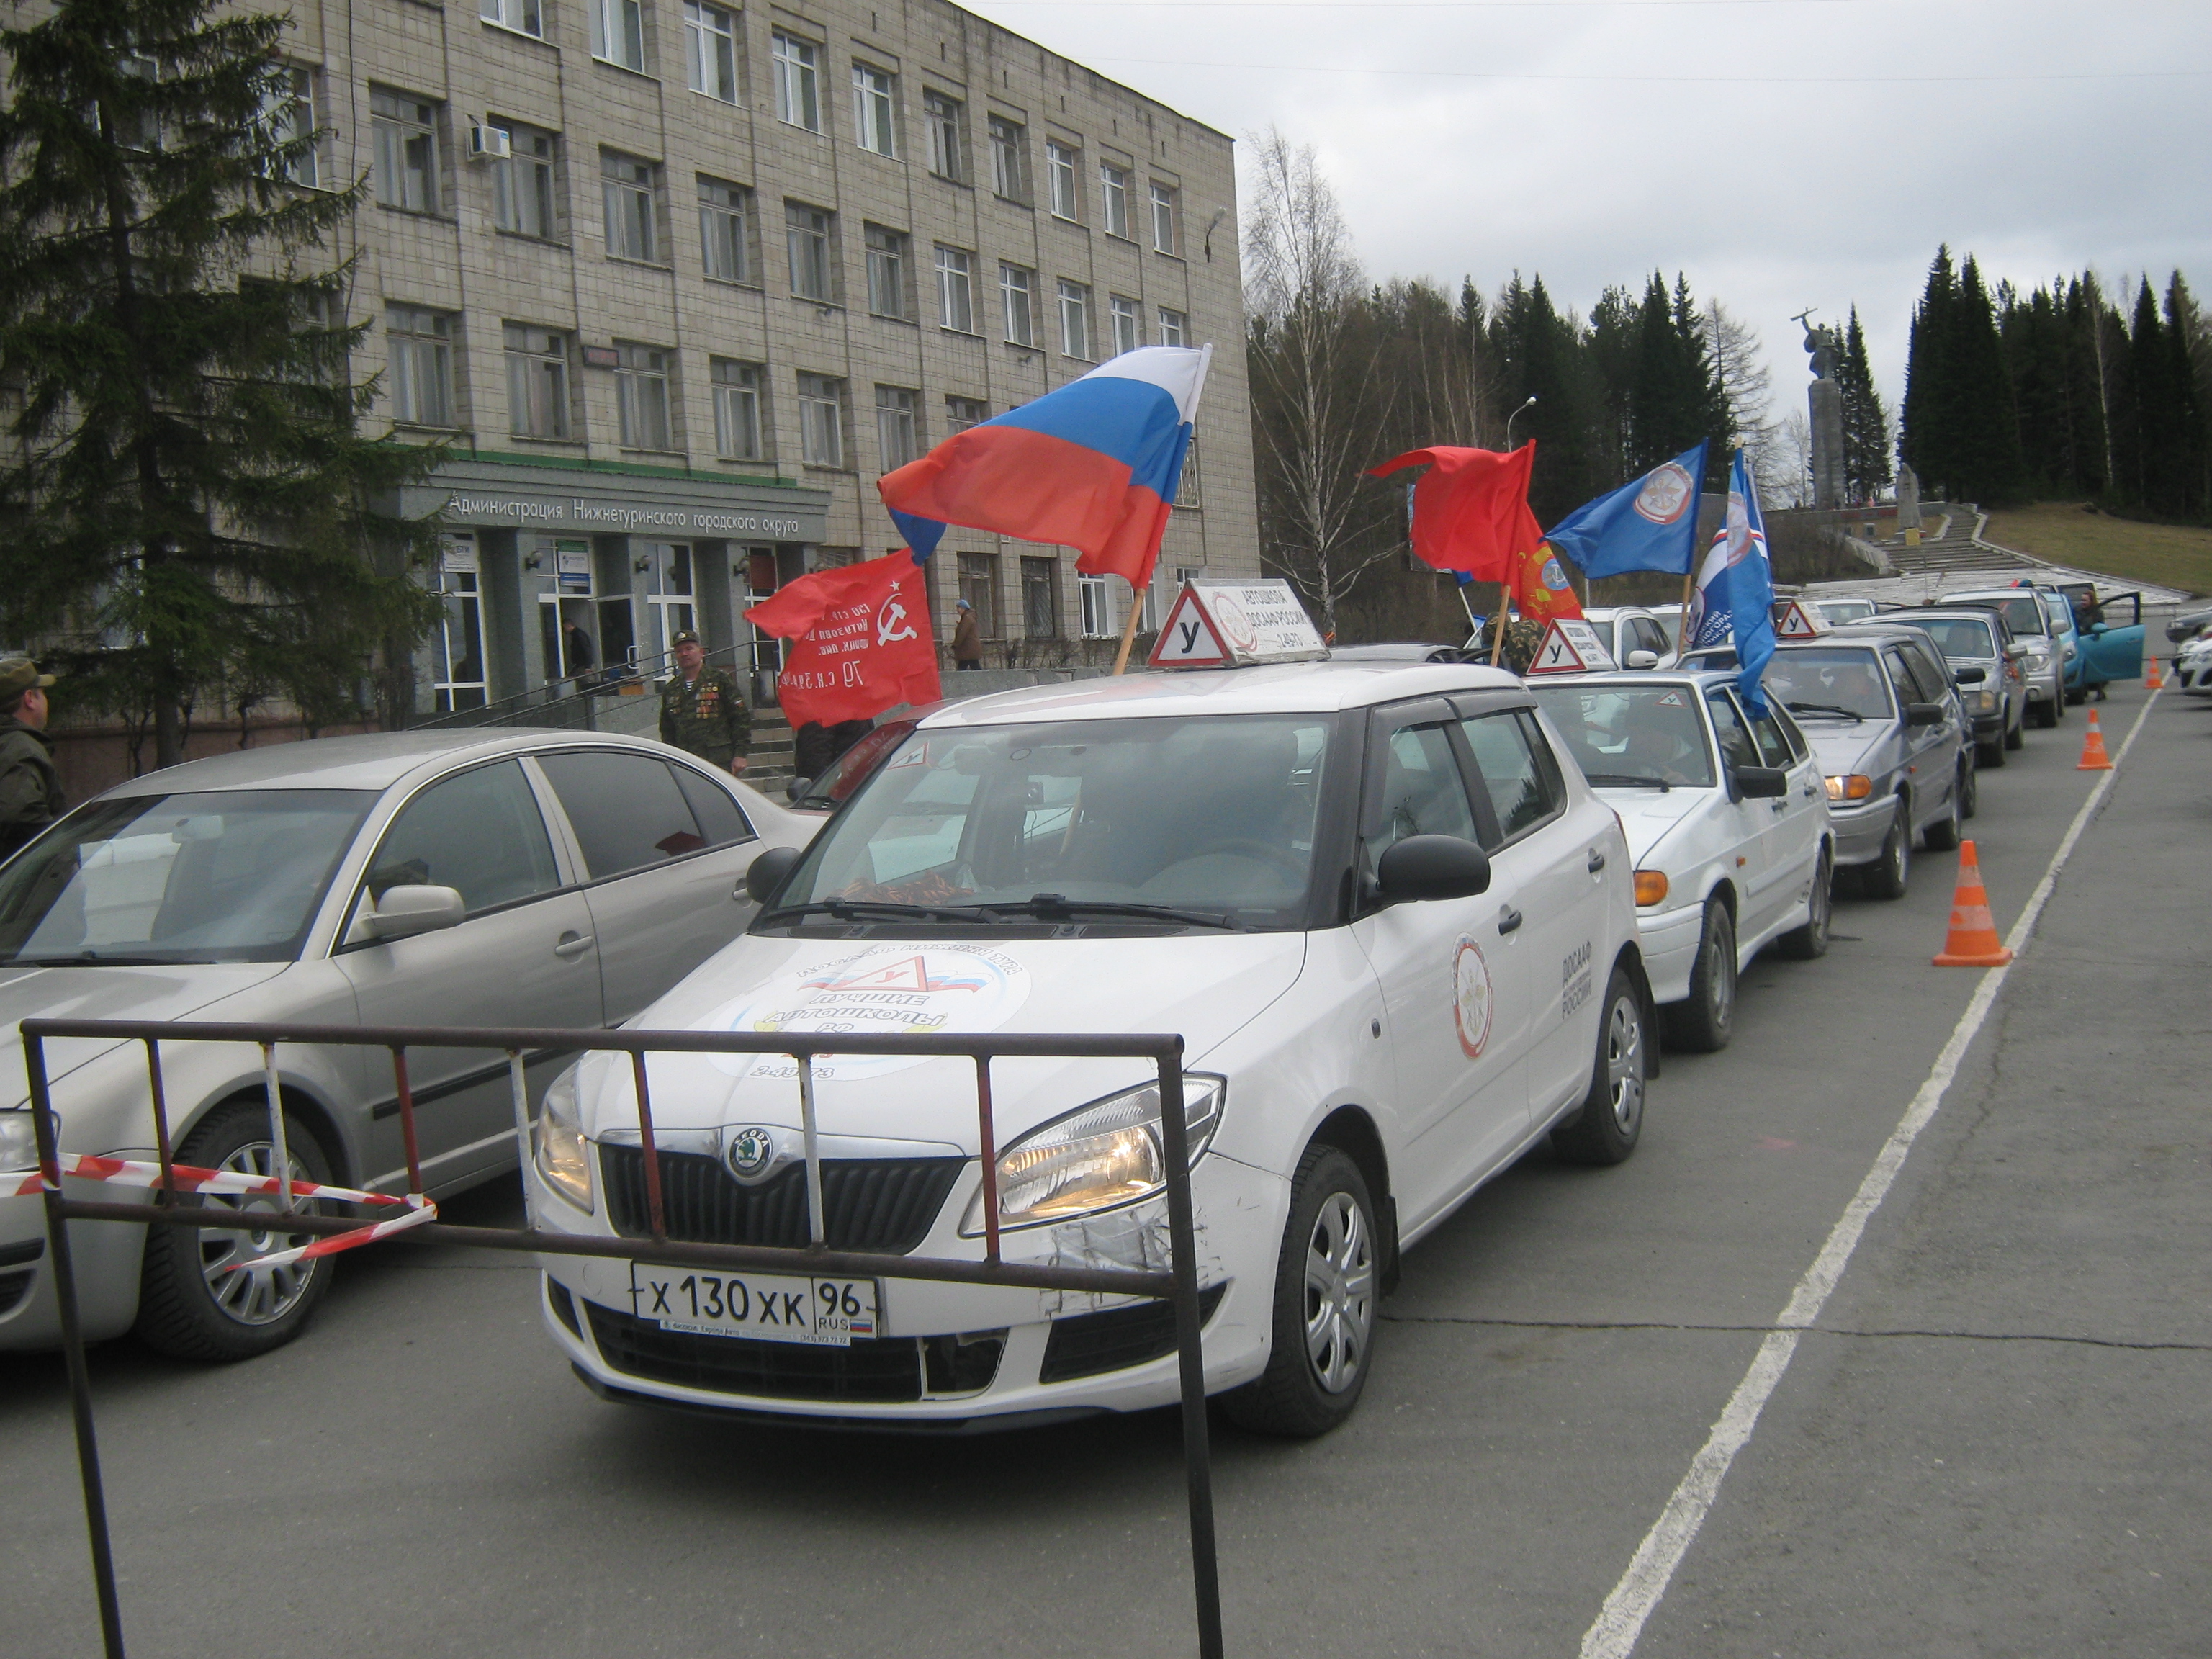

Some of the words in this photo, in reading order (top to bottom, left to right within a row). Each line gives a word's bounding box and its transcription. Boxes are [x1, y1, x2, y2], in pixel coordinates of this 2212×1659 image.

[450, 491, 563, 523] Администрация
[573, 499, 685, 529] Нижнетуринского
[693, 513, 756, 534] городского
[763, 518, 799, 537] округа
[1246, 611, 1280, 629] ДОСААФ
[1275, 611, 1308, 626] РОССИИ
[1789, 618, 1799, 632] У
[1179, 621, 1200, 654] У
[1550, 644, 1562, 663] У
[900, 943, 994, 958] НИЖНЯЯ
[988, 950, 1025, 976] ТУРА
[809, 993, 930, 1007] ЛУЧШИЕ
[763, 1007, 948, 1026] АВТОШКОЛЫ
[815, 1022, 855, 1033] РФ
[750, 1065, 835, 1079] 2-4973
[818, 1282, 861, 1317] 96
[819, 1318, 849, 1331] RUS
